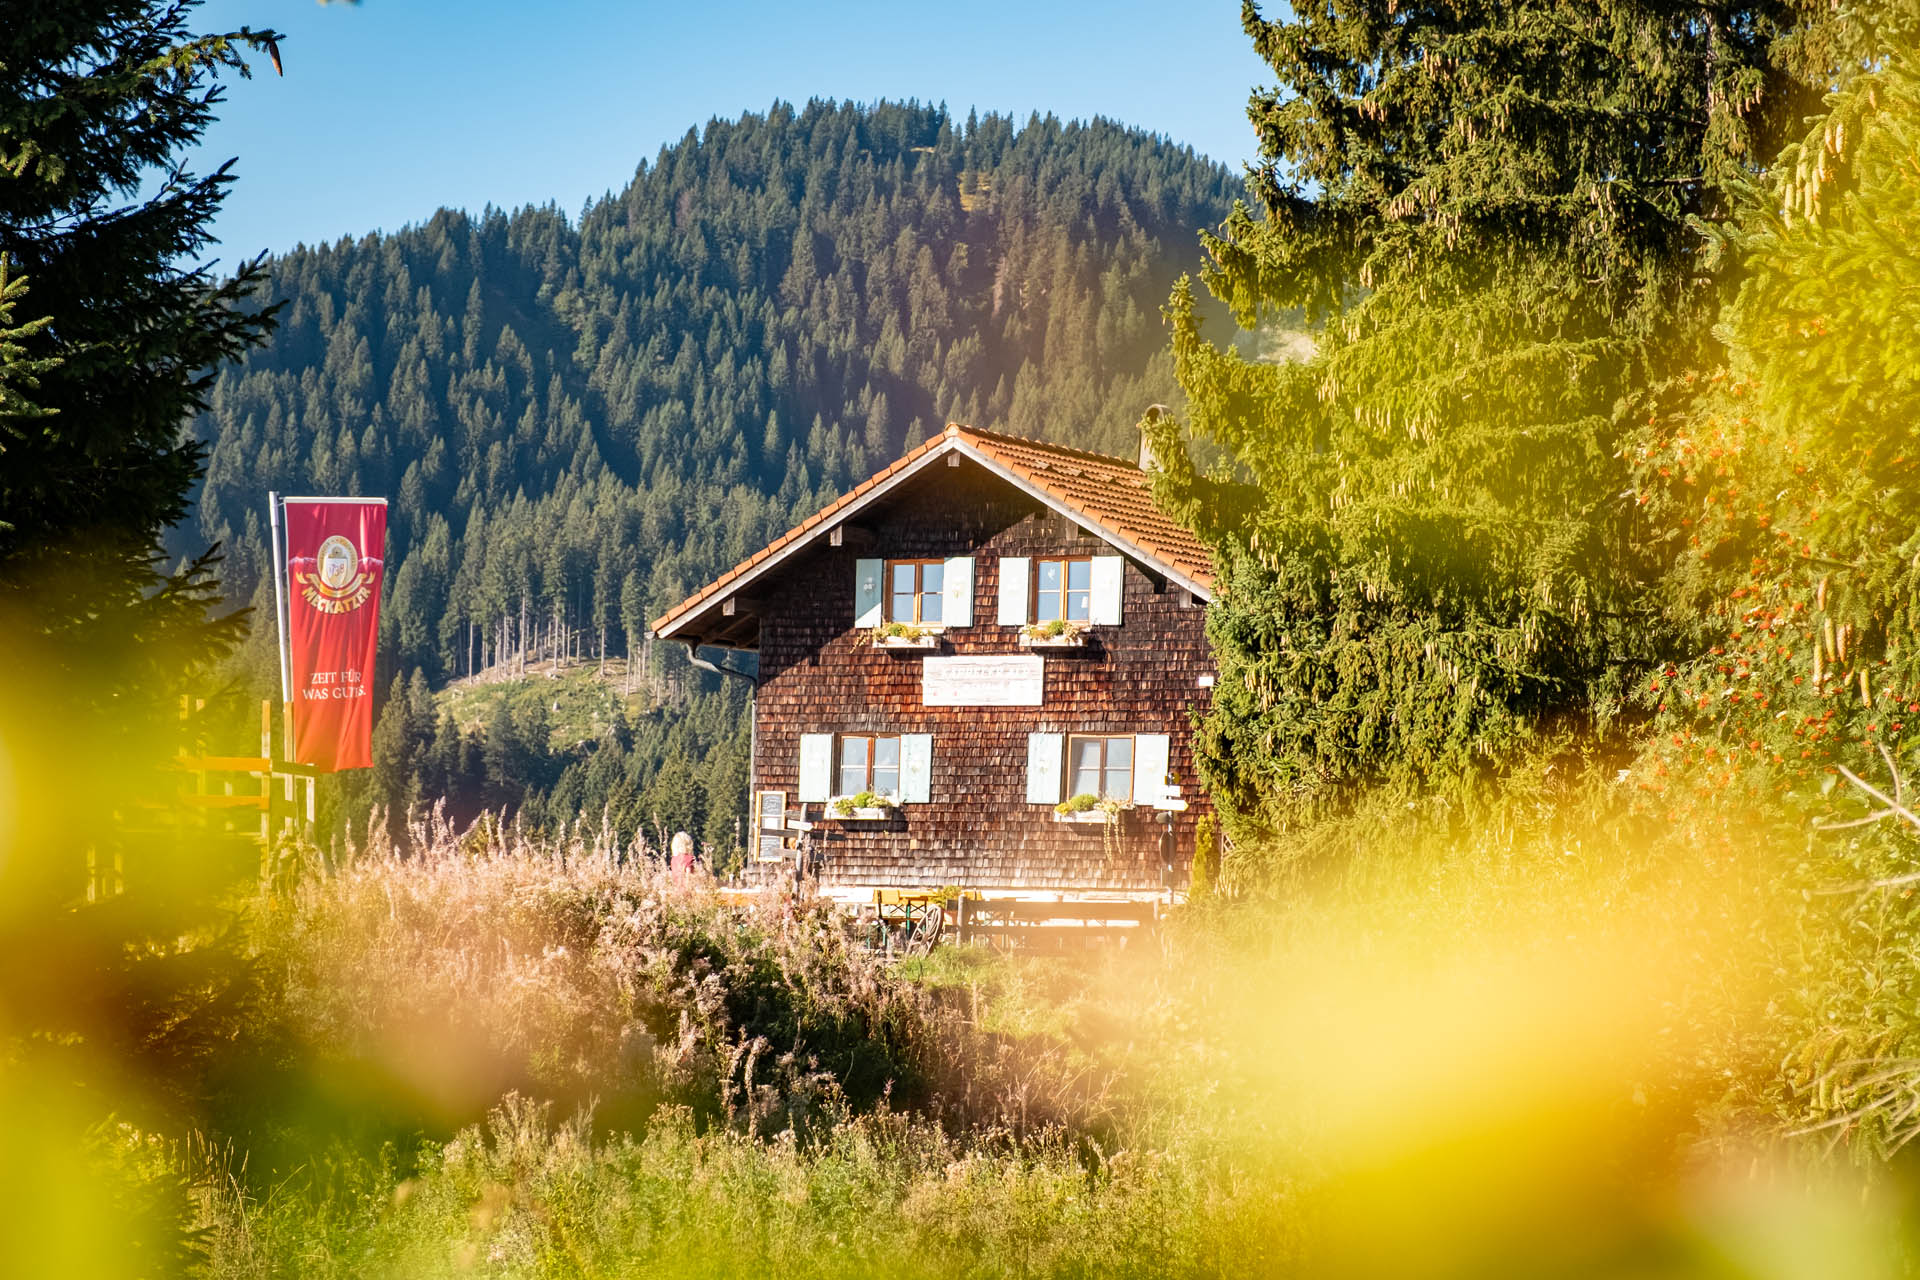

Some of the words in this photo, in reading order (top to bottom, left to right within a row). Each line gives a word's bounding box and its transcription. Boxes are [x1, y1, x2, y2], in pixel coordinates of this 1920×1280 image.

[302, 587, 371, 614] MECKATZER
[311, 672, 337, 684] ZEIT
[341, 669, 361, 683] FÜR
[303, 688, 329, 700] WAS
